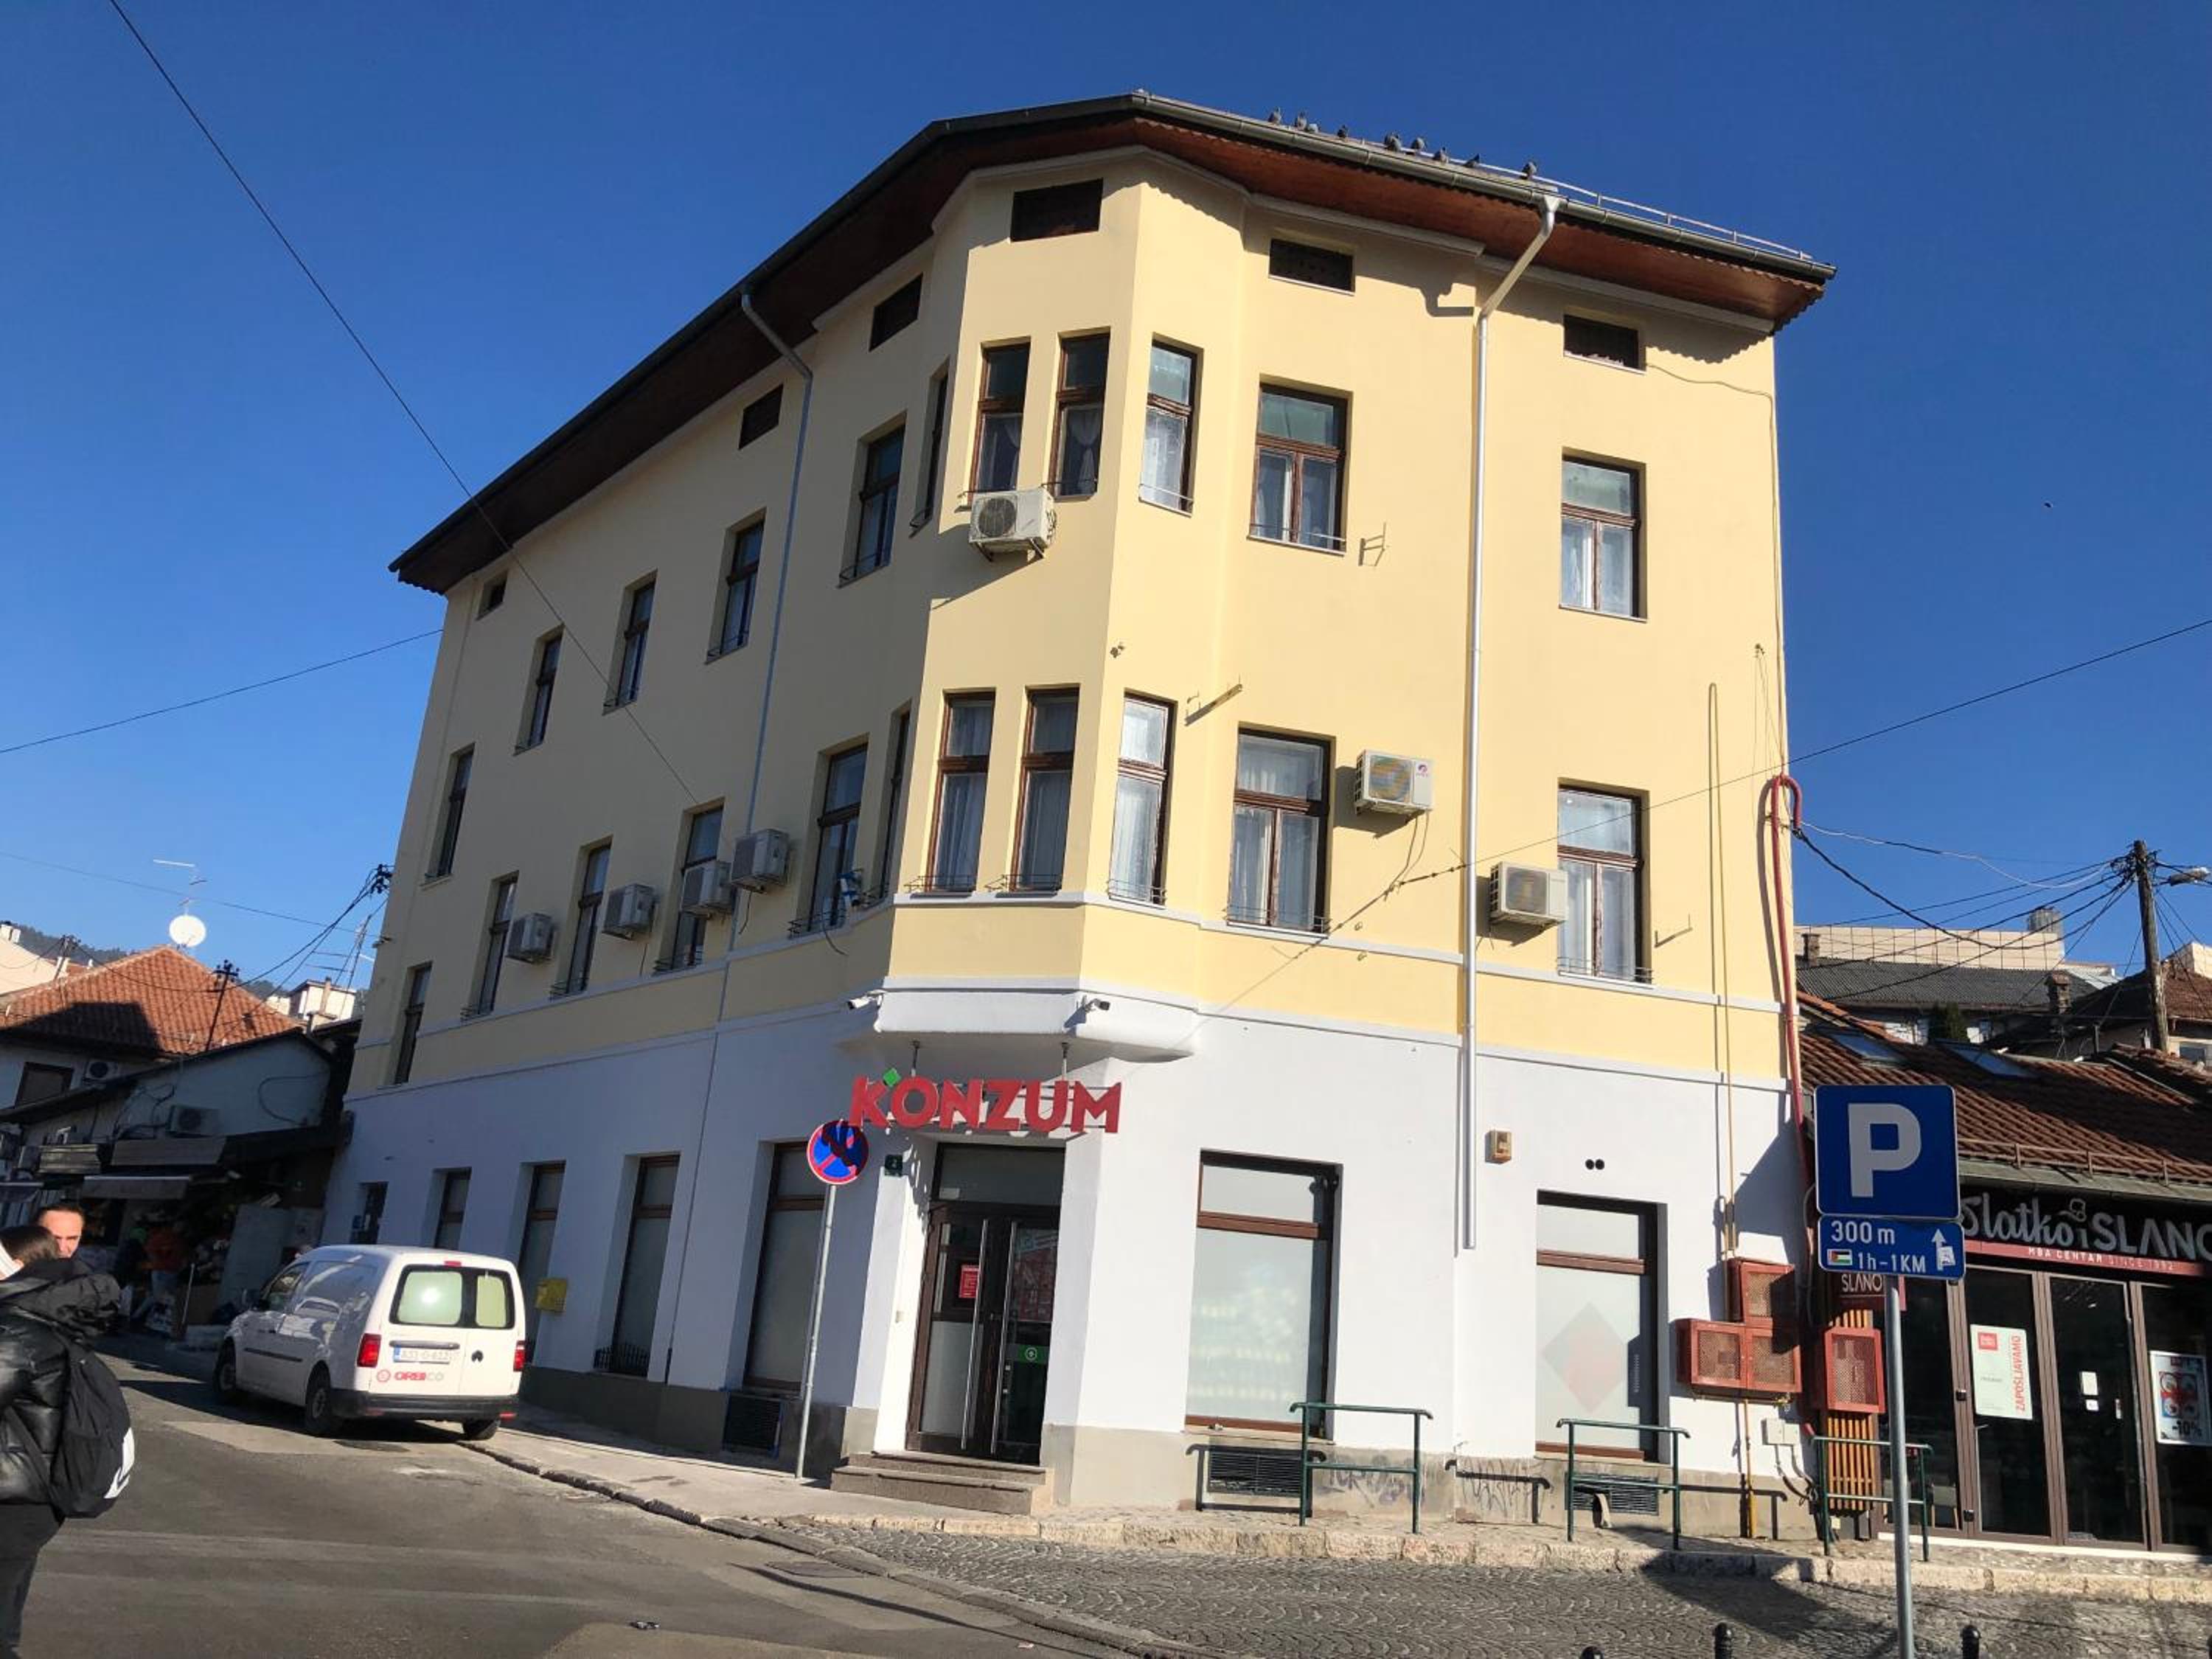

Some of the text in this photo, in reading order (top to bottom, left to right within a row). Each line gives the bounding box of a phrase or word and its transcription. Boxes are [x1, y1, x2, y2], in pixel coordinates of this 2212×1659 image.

[848, 1074, 1123, 1133] KONZUM
[1848, 1102, 1921, 1198] P
[1831, 1220, 1896, 1245] 300 m
[1841, 1273, 1883, 1292] SLANO
